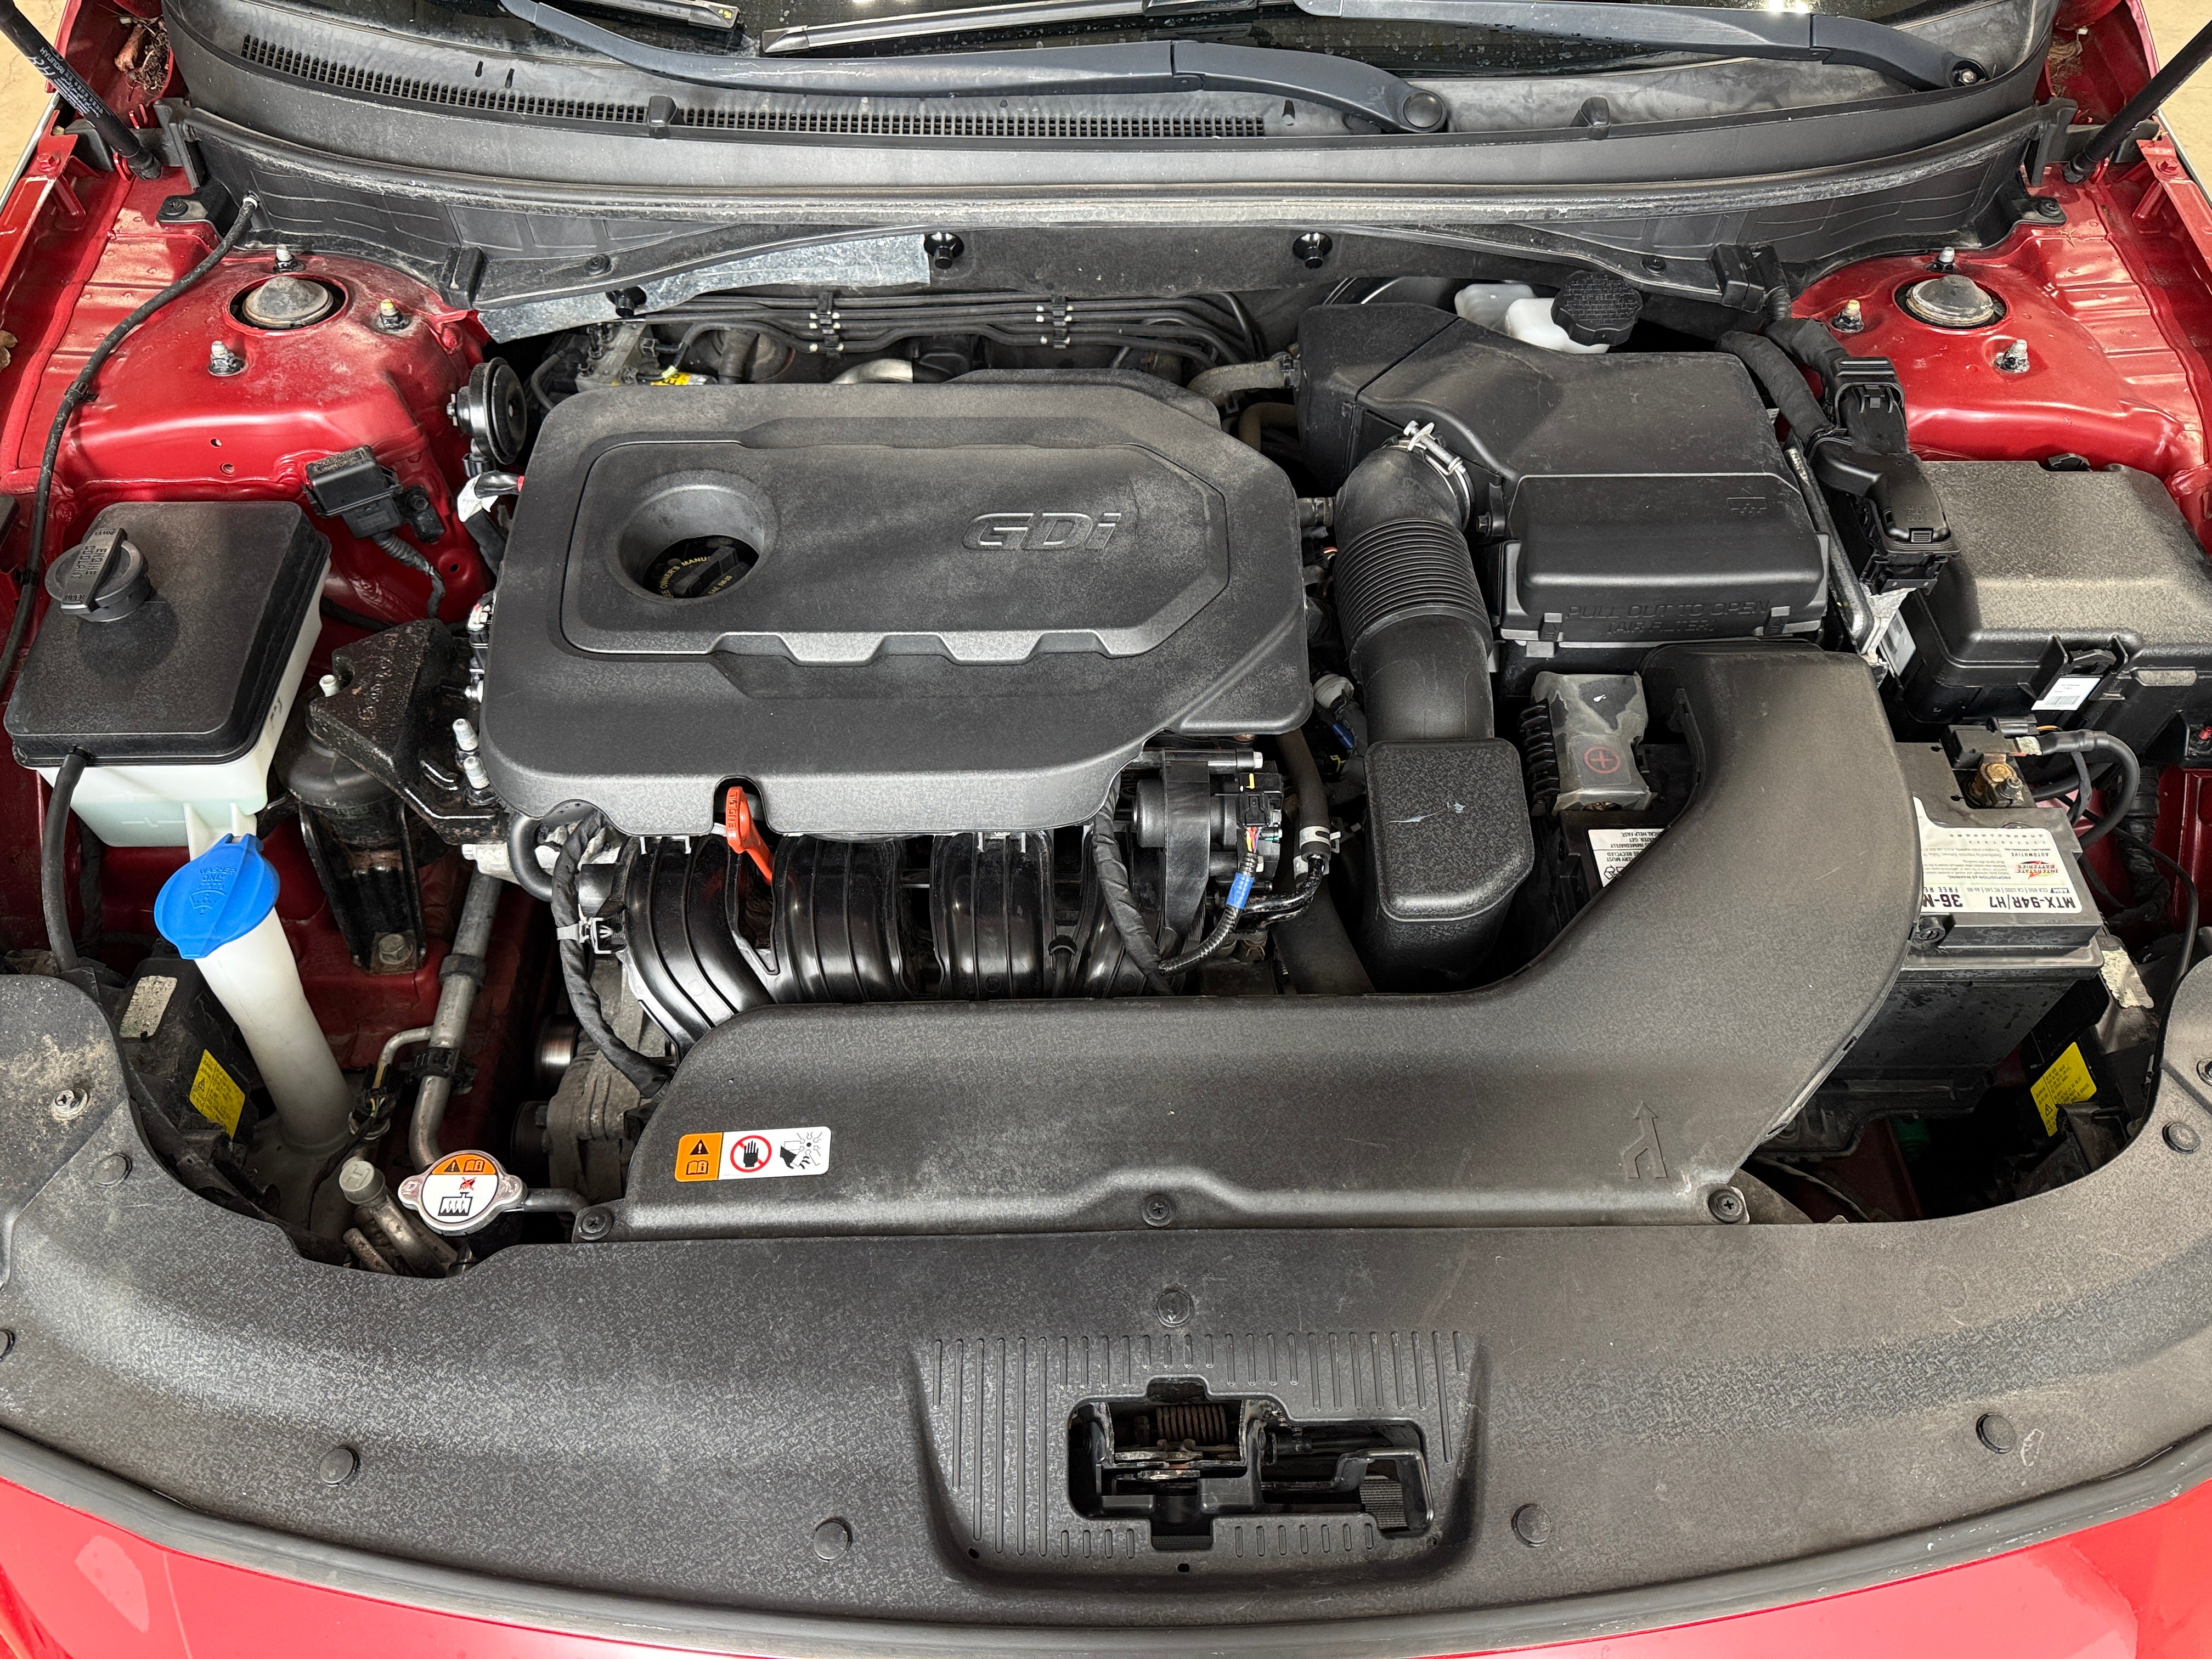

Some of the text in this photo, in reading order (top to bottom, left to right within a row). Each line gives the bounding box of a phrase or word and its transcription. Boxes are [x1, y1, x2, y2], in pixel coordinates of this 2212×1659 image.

[40, 47, 65, 75] HYUNDAI
[962, 512, 1122, 550] GDi
[71, 545, 96, 579] COOLANT
[85, 548, 108, 575] ENGINE
[660, 566, 681, 589] OWNER'S
[681, 556, 711, 567] MANU
[708, 575, 733, 595] SAE 5W-20
[1565, 600, 1770, 619] PULL OUT TO OPEN
[728, 808, 736, 829] ENG
[200, 866, 236, 876] WASHER
[1922, 894, 1963, 908] 36-M
[1989, 894, 2076, 910] MTX-94R/H7
